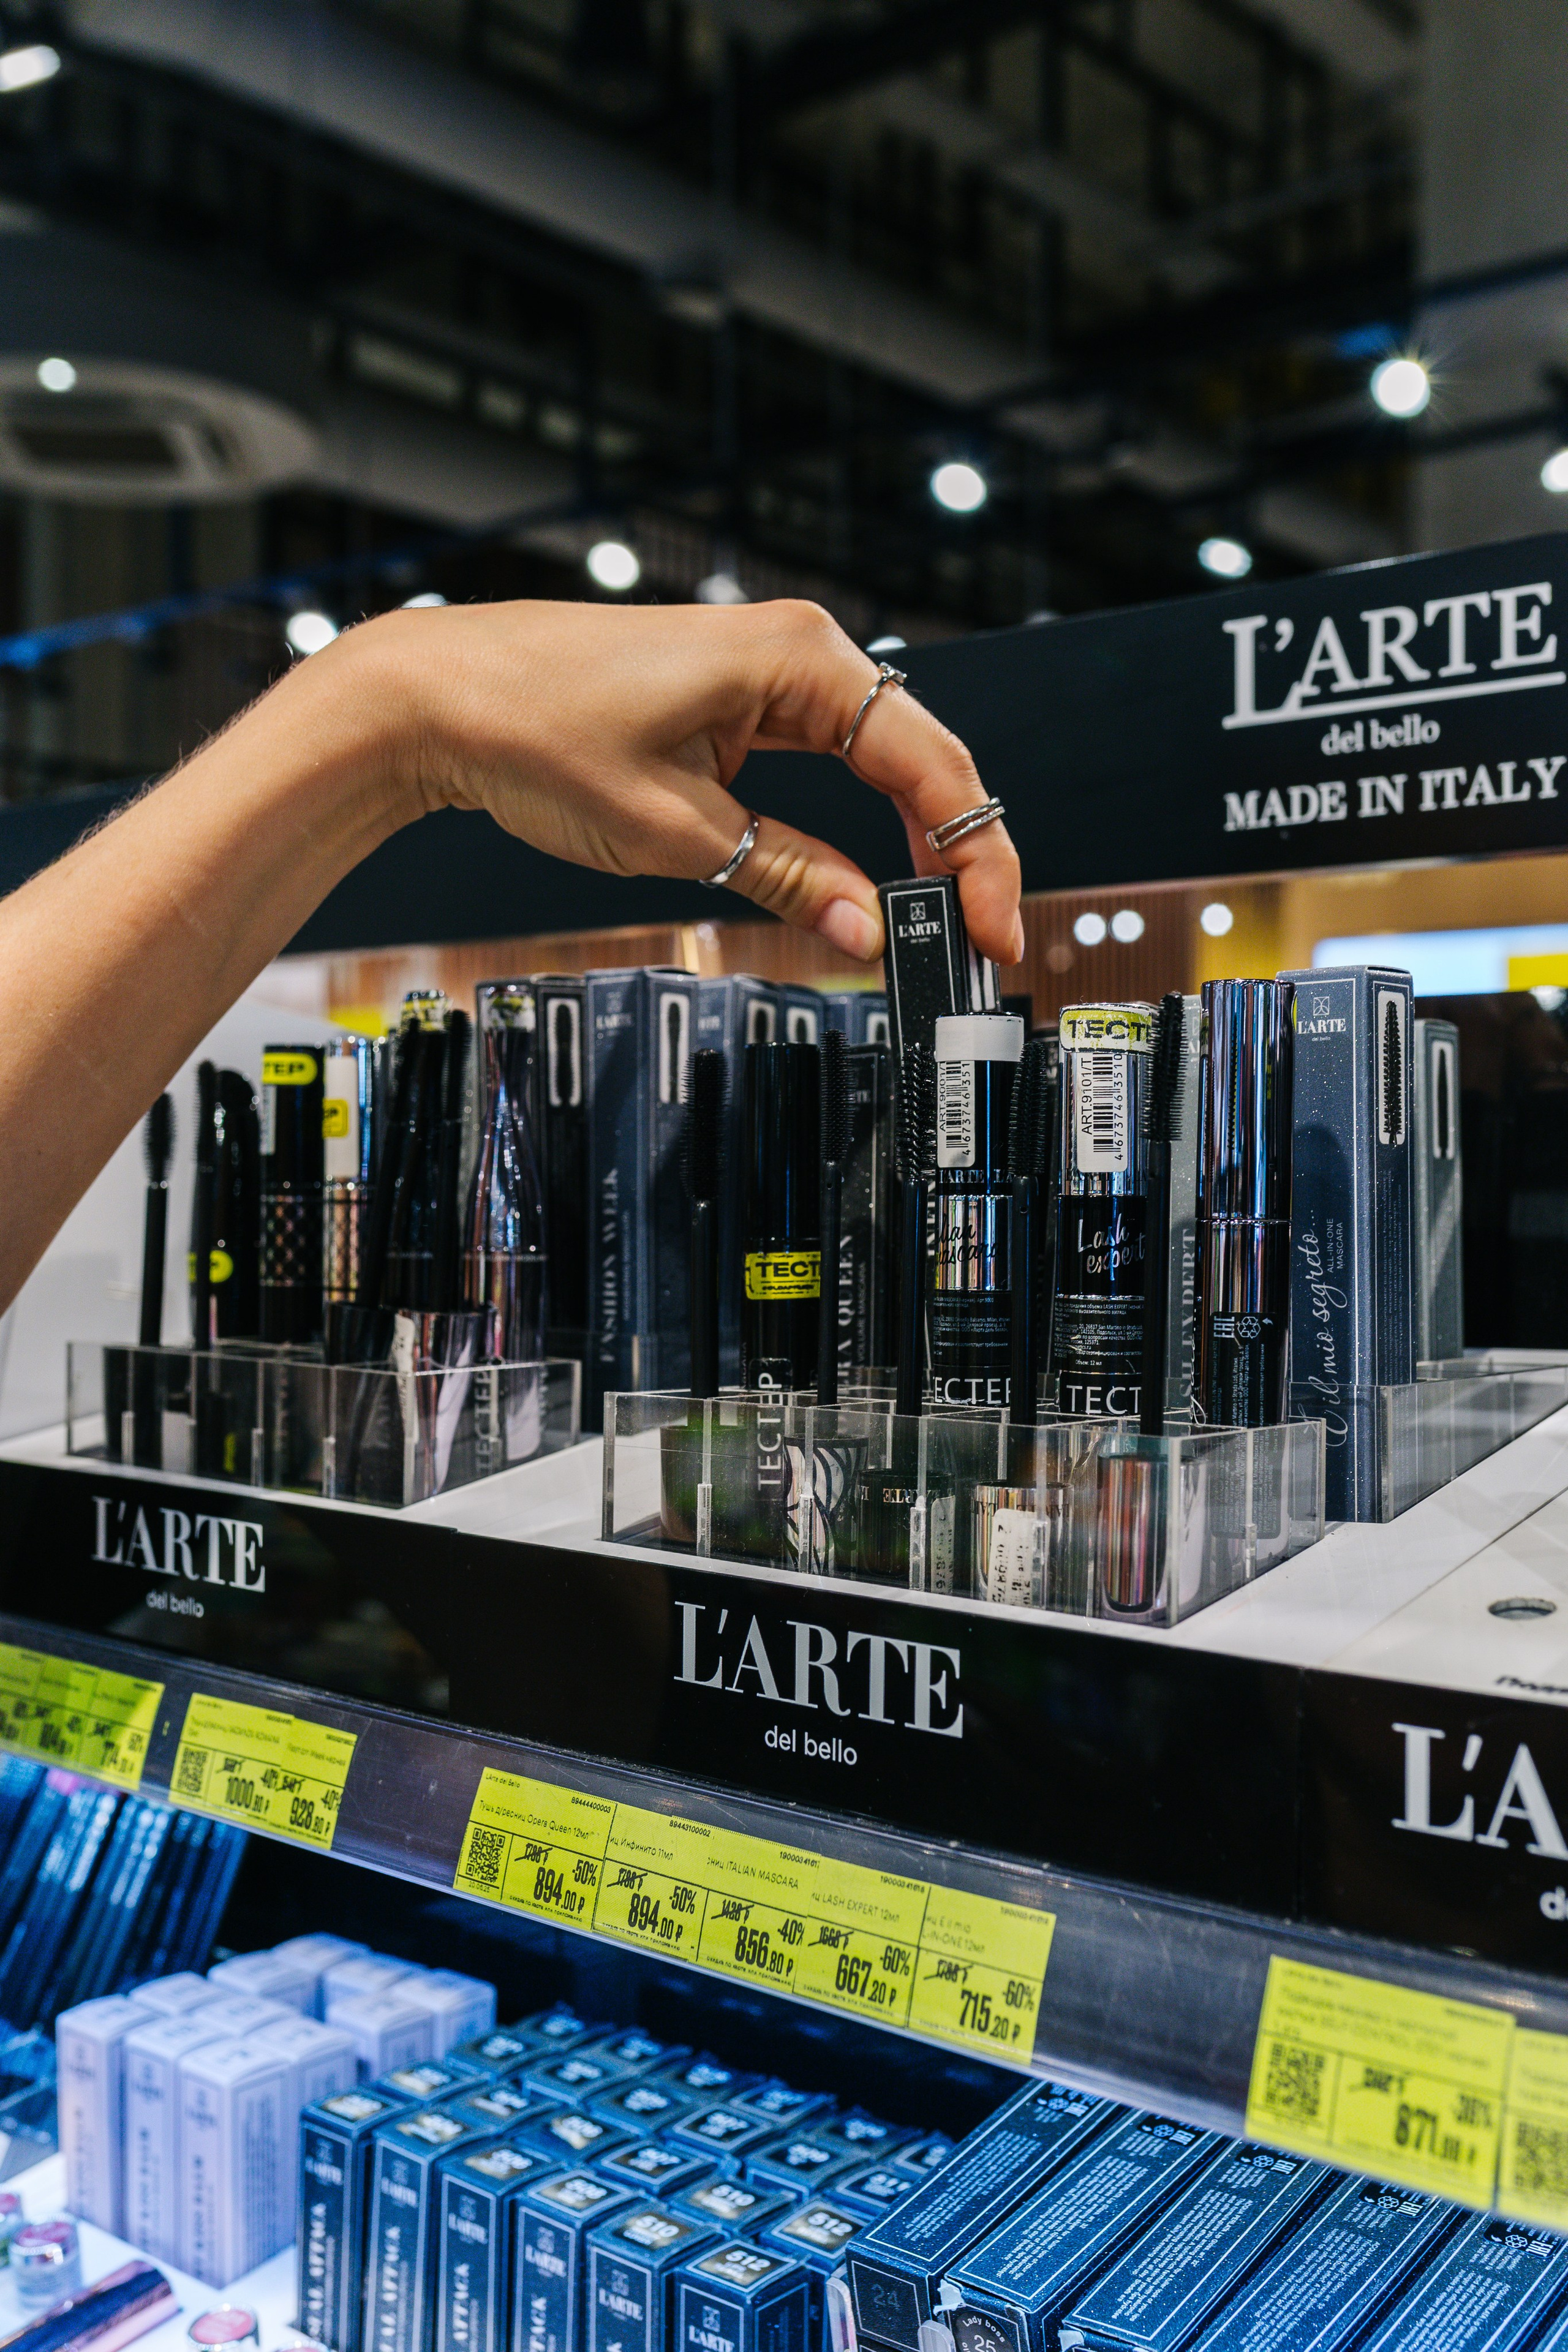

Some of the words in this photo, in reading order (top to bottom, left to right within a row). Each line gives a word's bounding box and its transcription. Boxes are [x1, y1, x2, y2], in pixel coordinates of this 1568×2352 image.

[1223, 582, 1558, 729] L'ARTE
[1321, 725, 1364, 756] del
[1370, 714, 1440, 750] bello
[1224, 781, 1347, 832] MADE
[1357, 774, 1408, 818] IN
[1419, 756, 1567, 812] ITALY
[899, 921, 941, 938] L'ARTE
[1297, 1018, 1346, 1035] L'ARTE
[1081, 1057, 1093, 1135] ART.9101/T
[1077, 1213, 1129, 1253] Lash
[755, 1261, 820, 1278] ТЕСТ
[1087, 1232, 1146, 1281] expert
[1317, 1326, 1340, 1376] mio
[933, 1377, 1011, 1404] ЕСТЕ
[91, 1495, 266, 1593] L'ARTE
[146, 1591, 168, 1611] del
[170, 1593, 205, 1618] bello
[674, 1600, 963, 1738] L'ARTE
[764, 1725, 796, 1753] del
[804, 1731, 858, 1765] bello
[571, 1796, 611, 1813] 89444400003
[1391, 1722, 1568, 1861] L'A
[480, 1799, 494, 1812] Тушь
[494, 1806, 526, 1822] д/ресниц
[526, 1814, 548, 1828] Opera
[549, 1820, 571, 1833] Queen
[573, 1826, 589, 1839] 12мл
[669, 1819, 710, 1837] 89443100002
[620, 1838, 657, 1856] Инфинито
[657, 1848, 673, 1860] 11мл
[571, 1859, 598, 1886] -50%
[726, 1860, 756, 1877] ITALIAN
[758, 1870, 798, 1889] MASCARA
[533, 1867, 579, 1911] 894.00
[669, 1885, 696, 1914] -50%
[627, 1893, 677, 1939] 894.00
[822, 1894, 845, 1906] LASH
[846, 1899, 878, 1915] EXPERT
[777, 1918, 804, 1945] -40%
[734, 1926, 785, 1973] 856.80
[880, 1945, 910, 1975] -60%
[1236, 2199, 1253, 2214] ACQUA
[1396, 2201, 1423, 2217] EAC
[1221, 2214, 1241, 2232] PERLATA
[1202, 2238, 1218, 2251] Gloss,
[1363, 2241, 1381, 2256] ACQUA
[1525, 2239, 1553, 2257] EAC
[962, 2315, 982, 2328] Lady
[985, 2321, 1006, 2343] boss
[973, 2334, 996, 2352] 25
